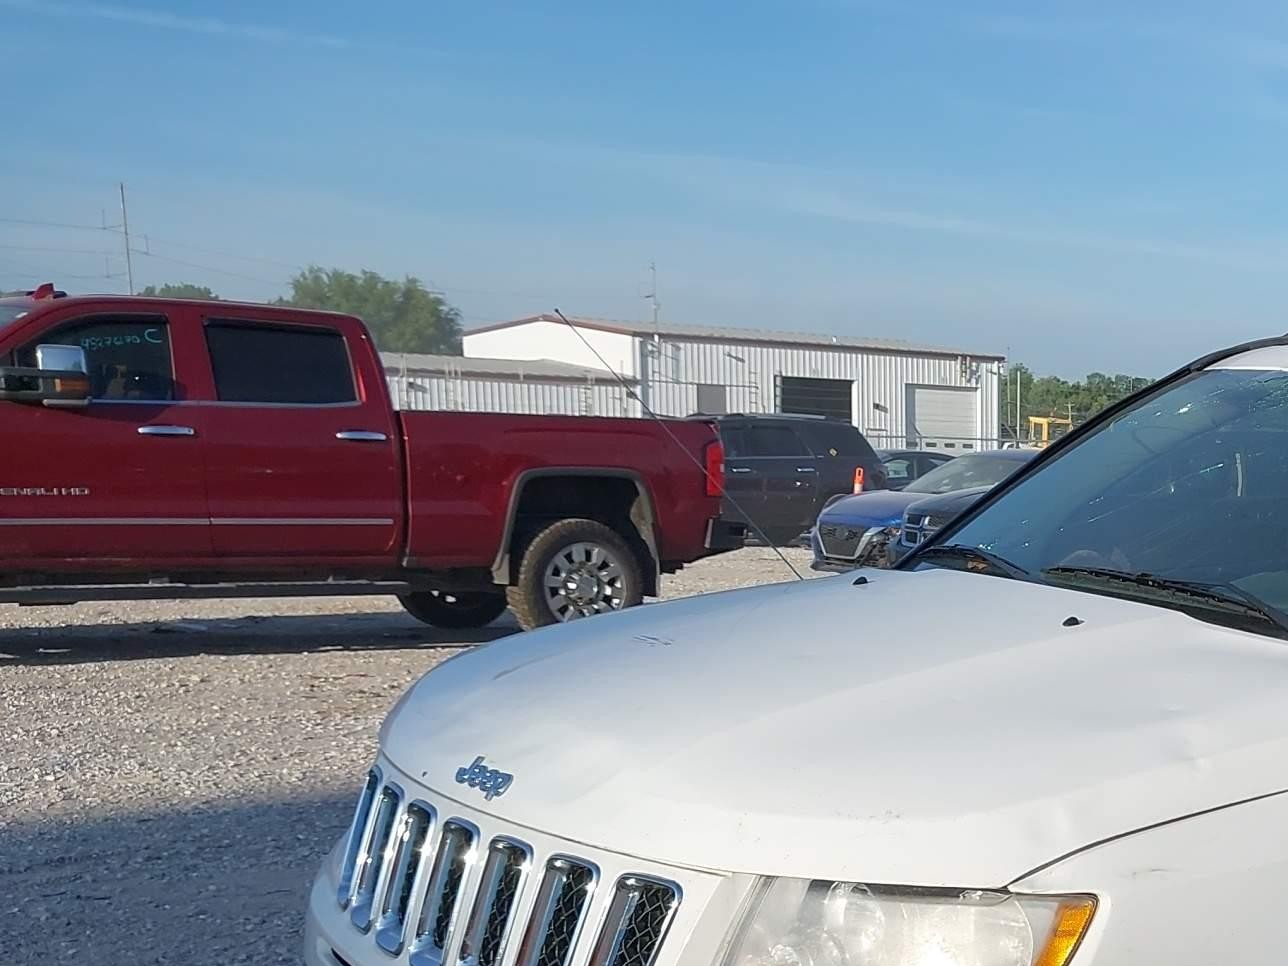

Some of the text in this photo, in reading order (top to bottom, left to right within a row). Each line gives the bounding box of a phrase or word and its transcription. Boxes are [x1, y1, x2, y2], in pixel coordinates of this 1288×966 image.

[144, 328, 162, 344] C
[0, 487, 90, 496] ENALI HD
[455, 755, 514, 802] Jeep
